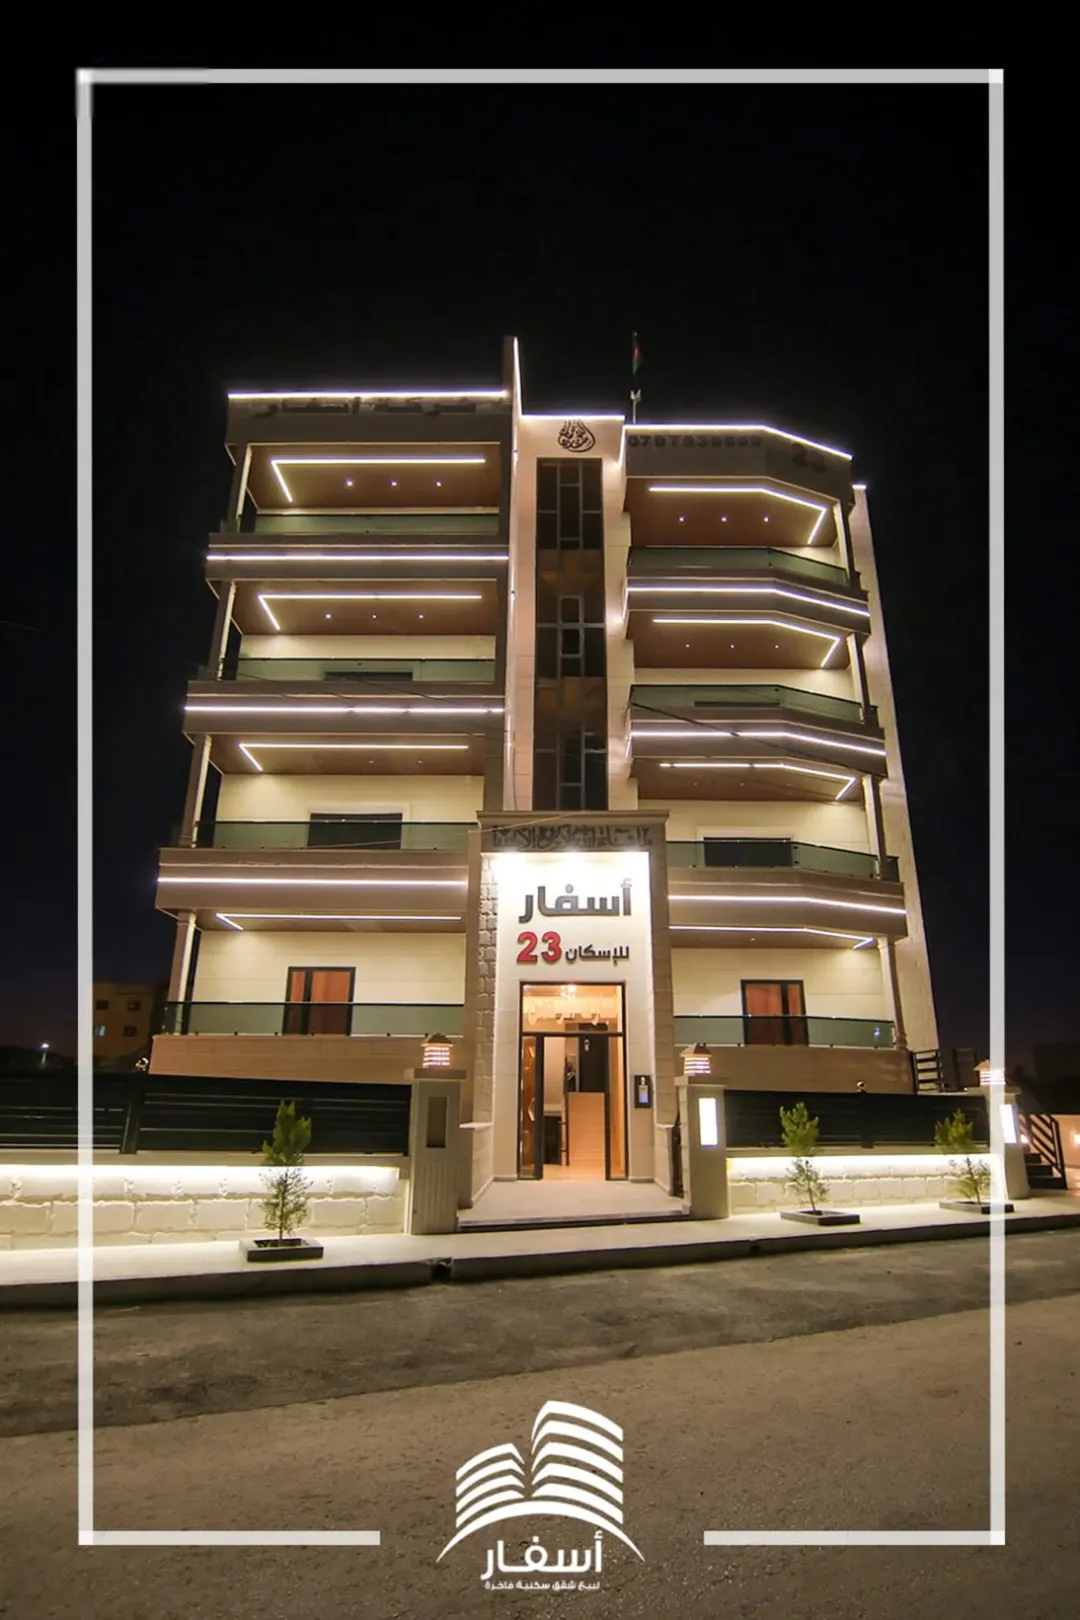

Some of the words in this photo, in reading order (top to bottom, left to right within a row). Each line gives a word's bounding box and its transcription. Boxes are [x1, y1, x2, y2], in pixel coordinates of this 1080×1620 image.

[518, 878, 632, 925] أسفار
[517, 931, 562, 965] 23
[565, 944, 630, 967] للإسكان
